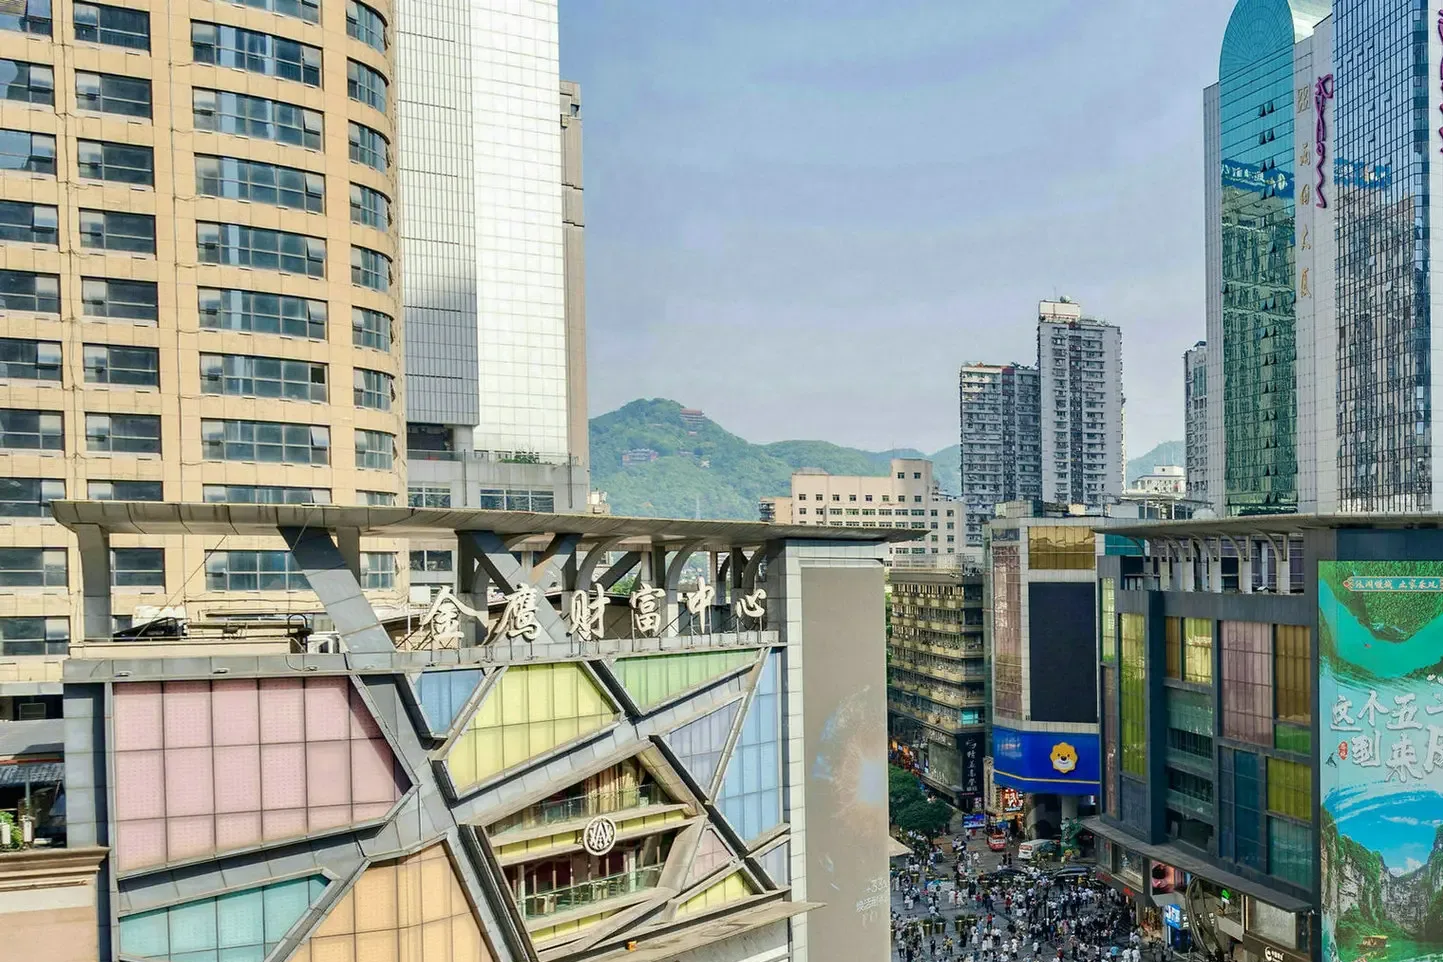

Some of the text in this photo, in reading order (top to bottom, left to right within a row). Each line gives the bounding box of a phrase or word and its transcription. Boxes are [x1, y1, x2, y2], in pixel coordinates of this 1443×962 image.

[421, 578, 767, 641] 金鹰财富中心
